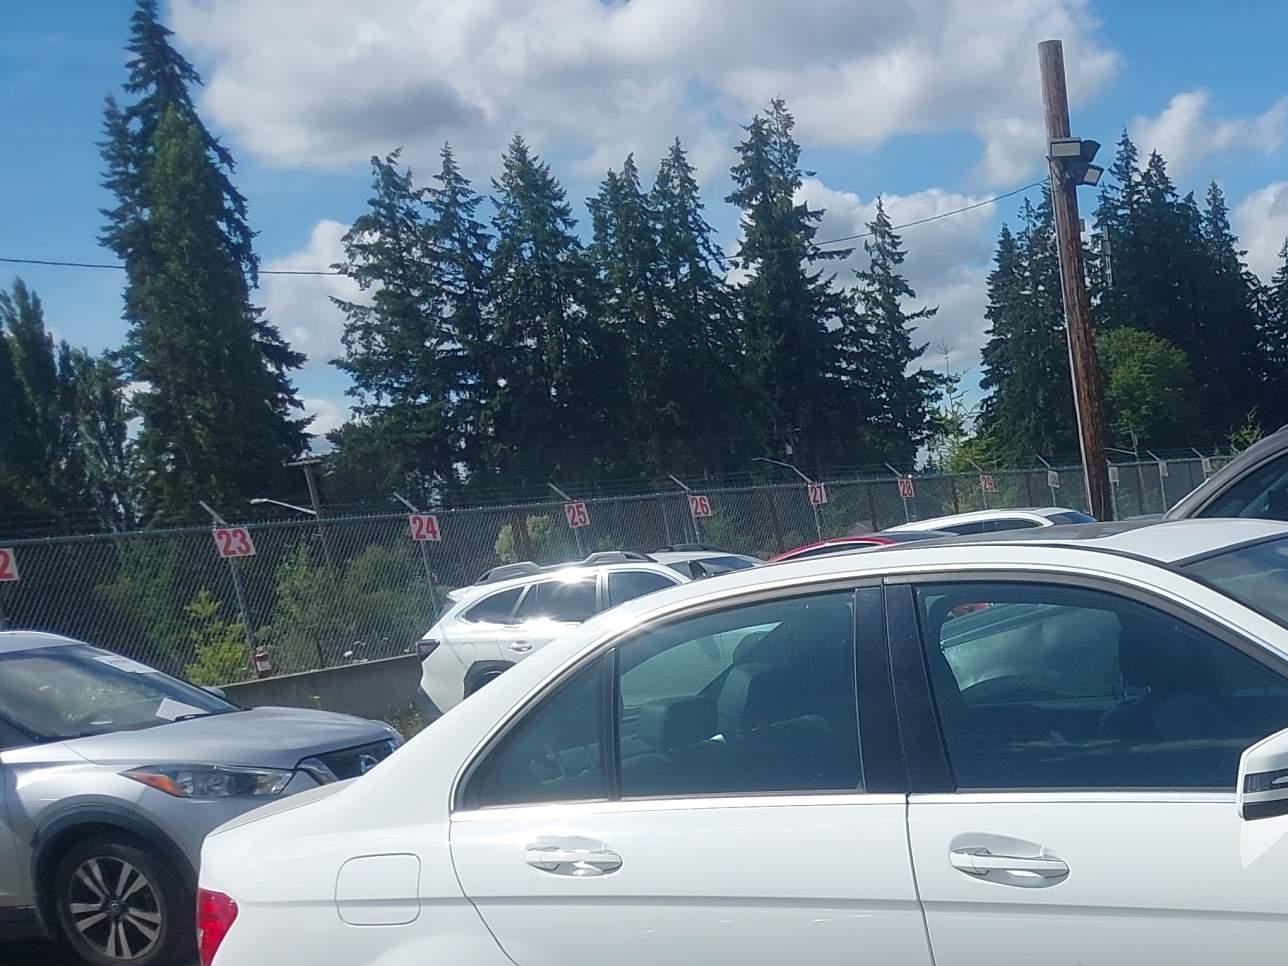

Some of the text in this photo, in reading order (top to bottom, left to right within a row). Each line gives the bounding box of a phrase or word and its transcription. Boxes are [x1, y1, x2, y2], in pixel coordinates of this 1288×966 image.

[811, 485, 823, 503] 27
[900, 480, 913, 496] 28
[567, 504, 587, 526] 25
[691, 496, 710, 515] 26
[412, 516, 438, 540] 24
[216, 529, 251, 556] 23
